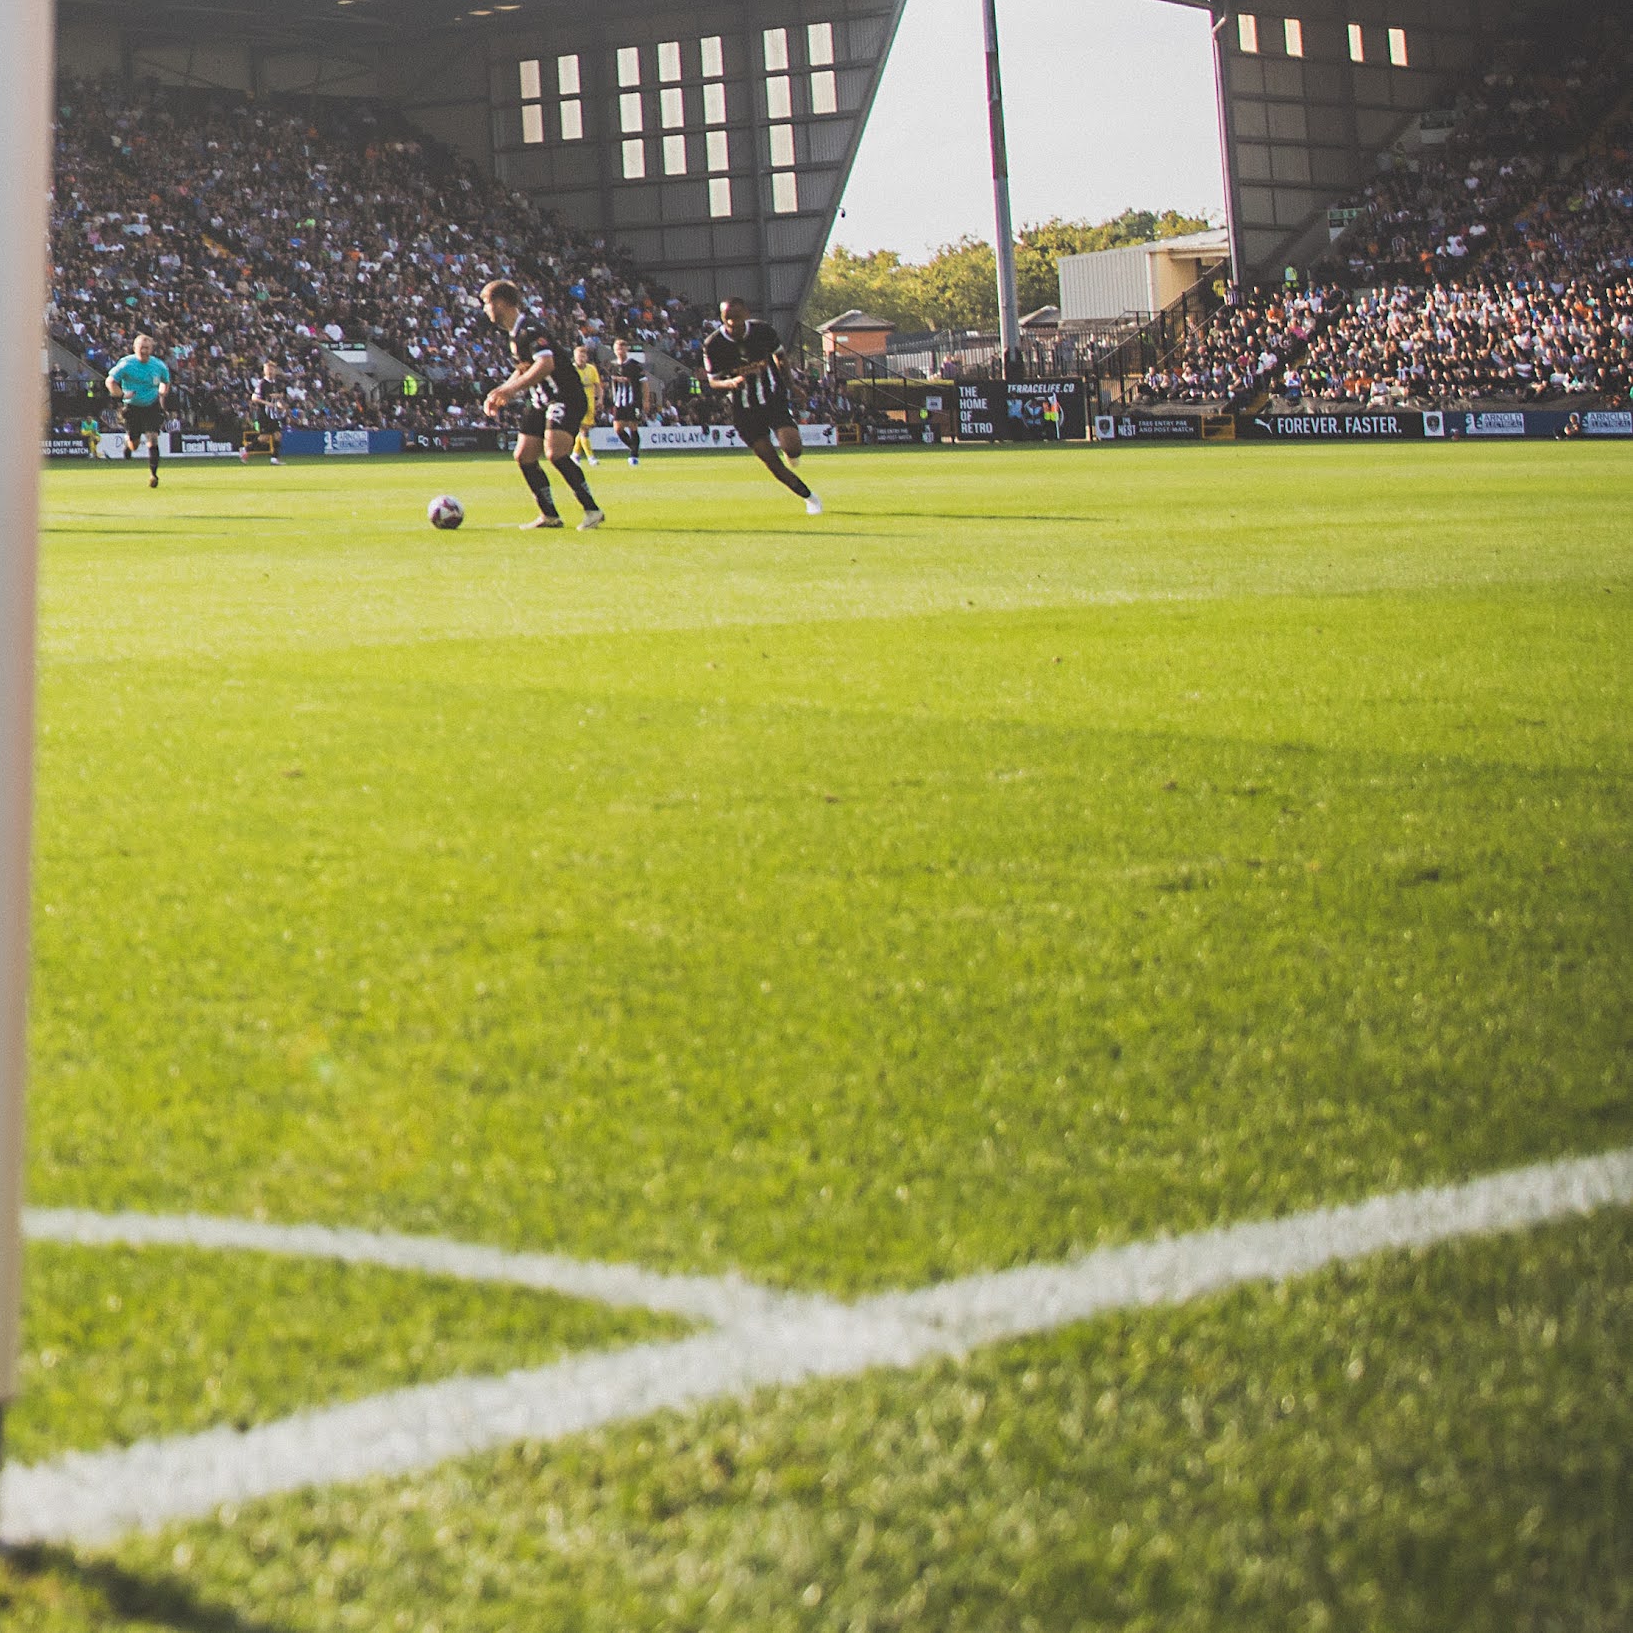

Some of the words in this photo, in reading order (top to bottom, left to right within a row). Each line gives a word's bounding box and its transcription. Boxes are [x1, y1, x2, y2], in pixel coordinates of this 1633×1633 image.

[959, 386, 978, 398] THE
[1007, 383, 1075, 393] TERRACELIFE.CO
[960, 398, 987, 410] HOME
[960, 411, 973, 423] OF
[1484, 413, 1522, 421] ARNOLD
[1590, 412, 1631, 421] ARNOLD
[961, 423, 993, 434] RETRO
[1118, 425, 1136, 436] NEST
[1277, 417, 1342, 434] FOREVER.
[1345, 416, 1403, 434] FASTER.
[52, 447, 89, 455] POST-MATCH
[181, 441, 206, 452] Local
[207, 440, 232, 452] News
